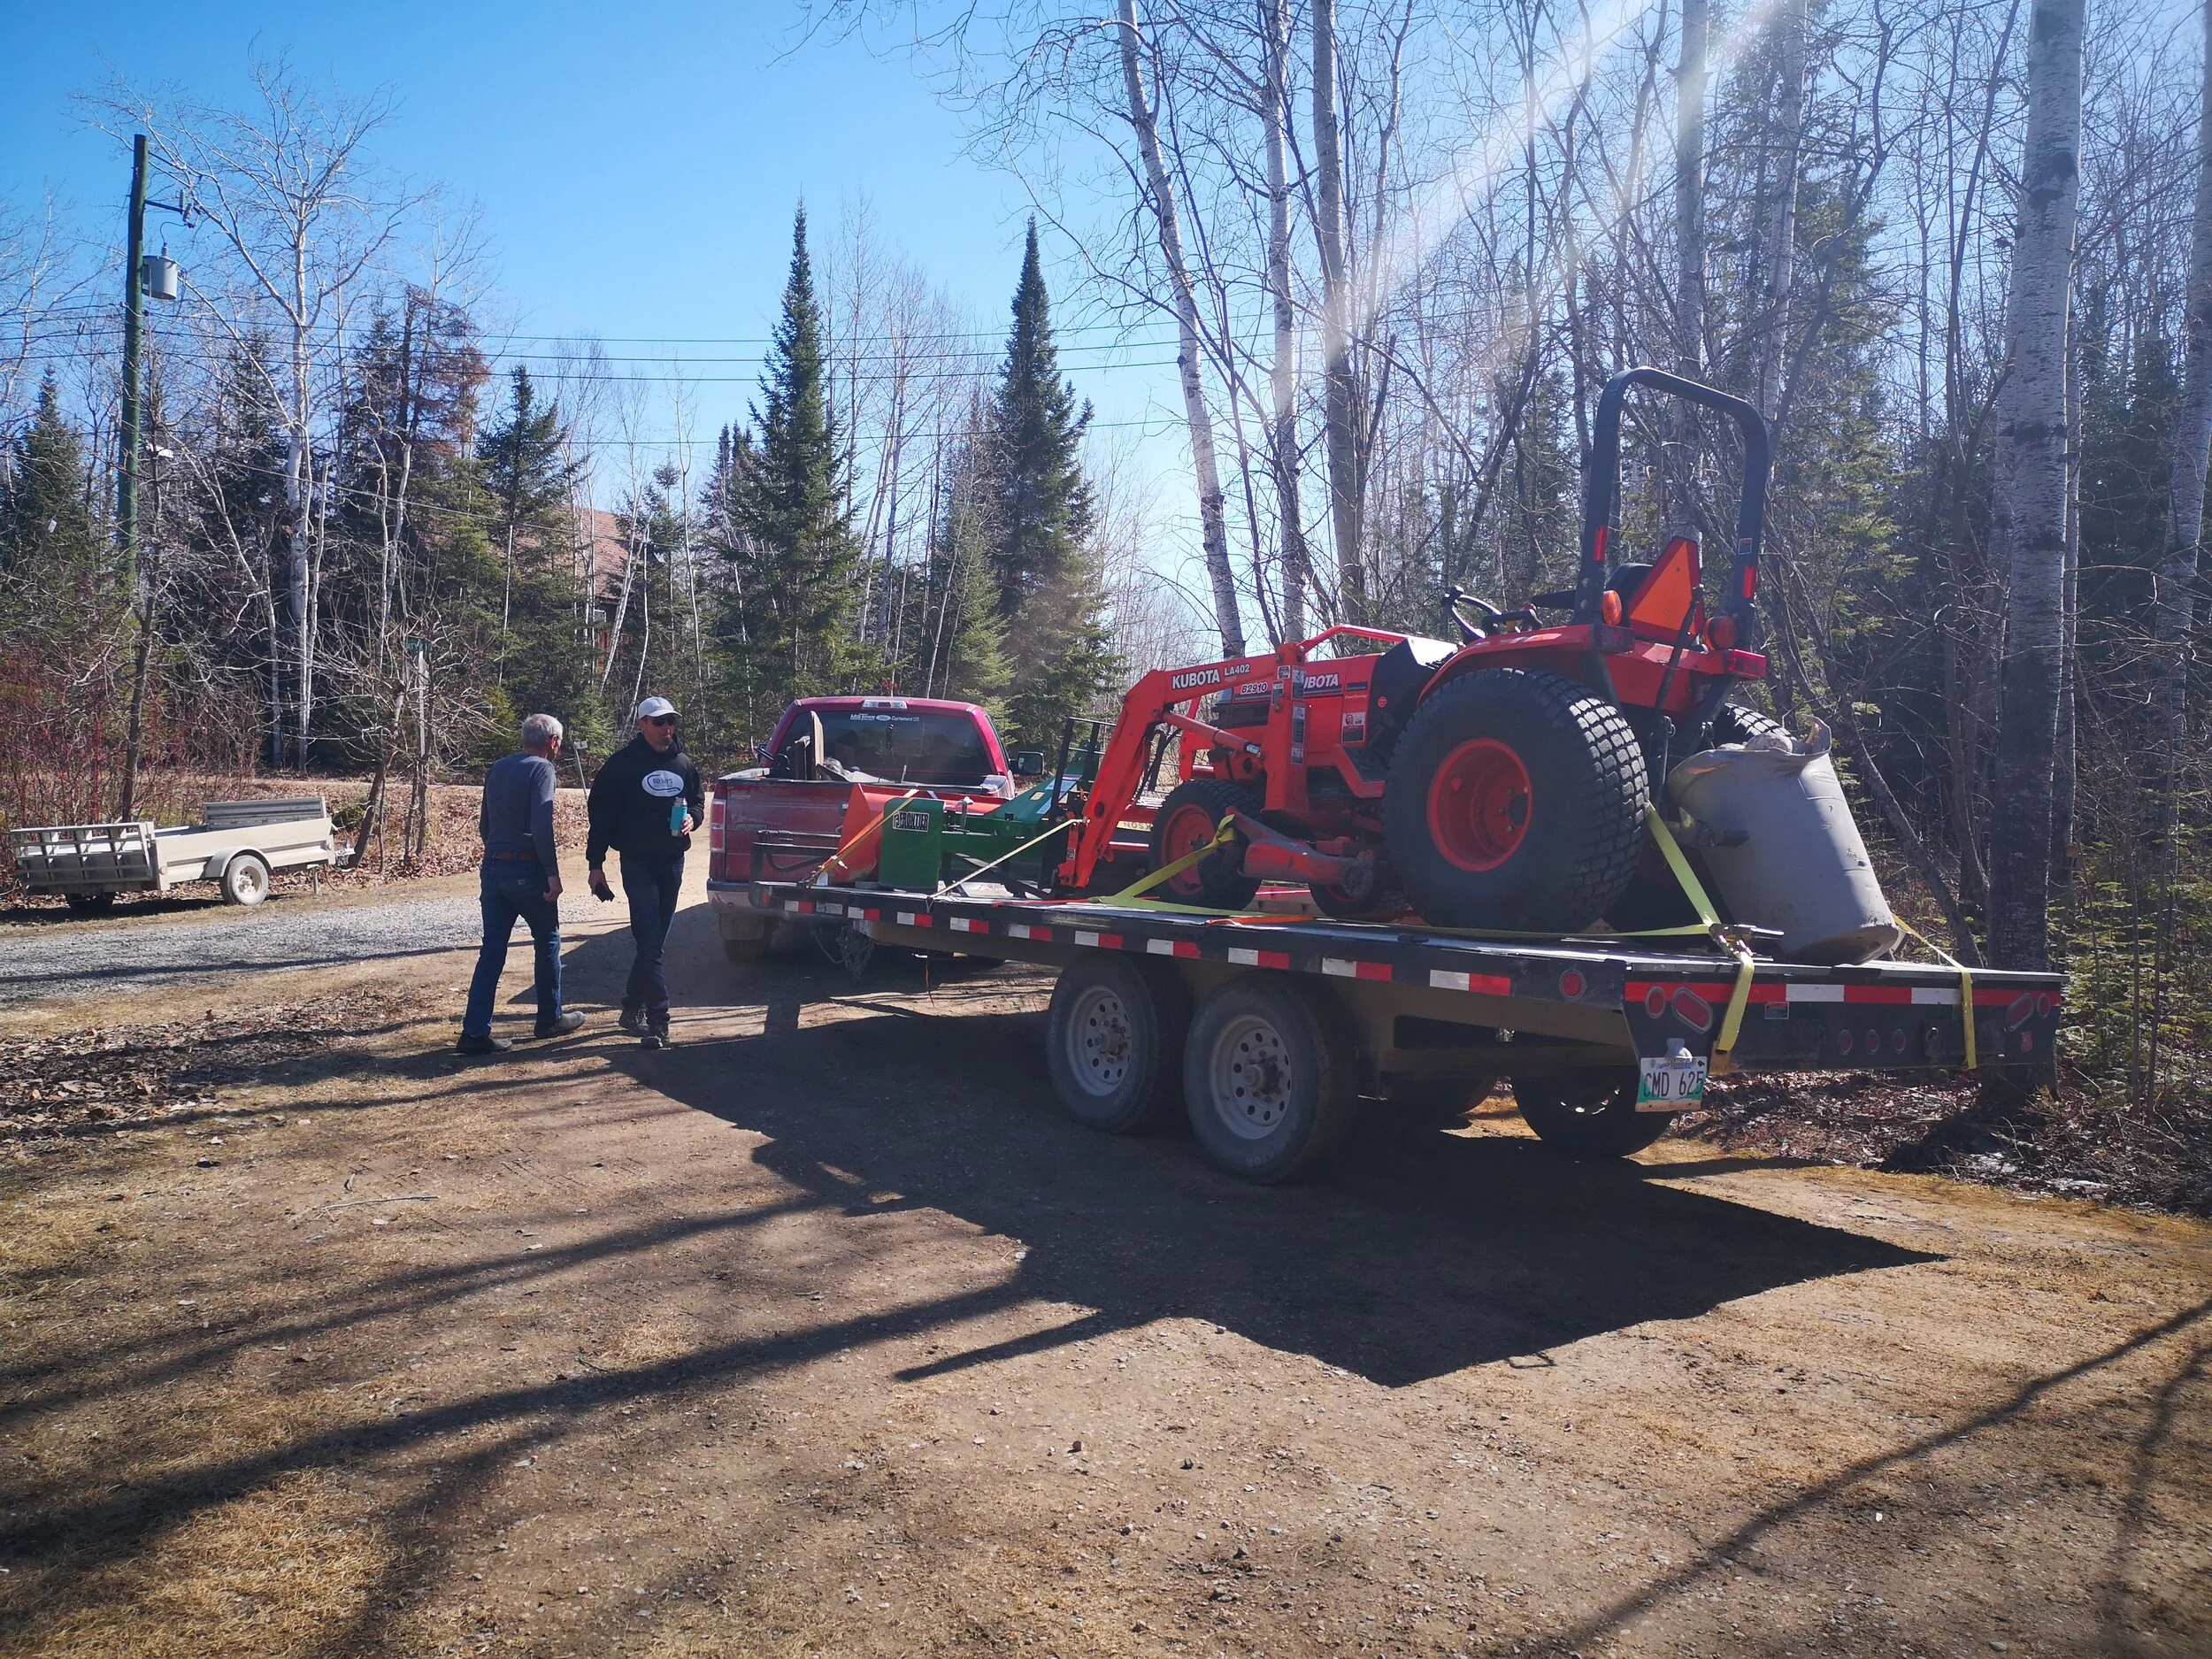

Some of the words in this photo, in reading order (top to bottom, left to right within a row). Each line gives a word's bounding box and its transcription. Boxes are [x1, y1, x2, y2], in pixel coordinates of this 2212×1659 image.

[1172, 669, 1220, 689] KUBOTA
[1224, 664, 1250, 677] LA402
[1303, 673, 1339, 689] BOTA
[1240, 681, 1268, 695] B2910
[900, 812, 929, 828] FRONTIER
[1643, 1071, 1670, 1098] CMD
[1678, 1071, 1704, 1096] 625
